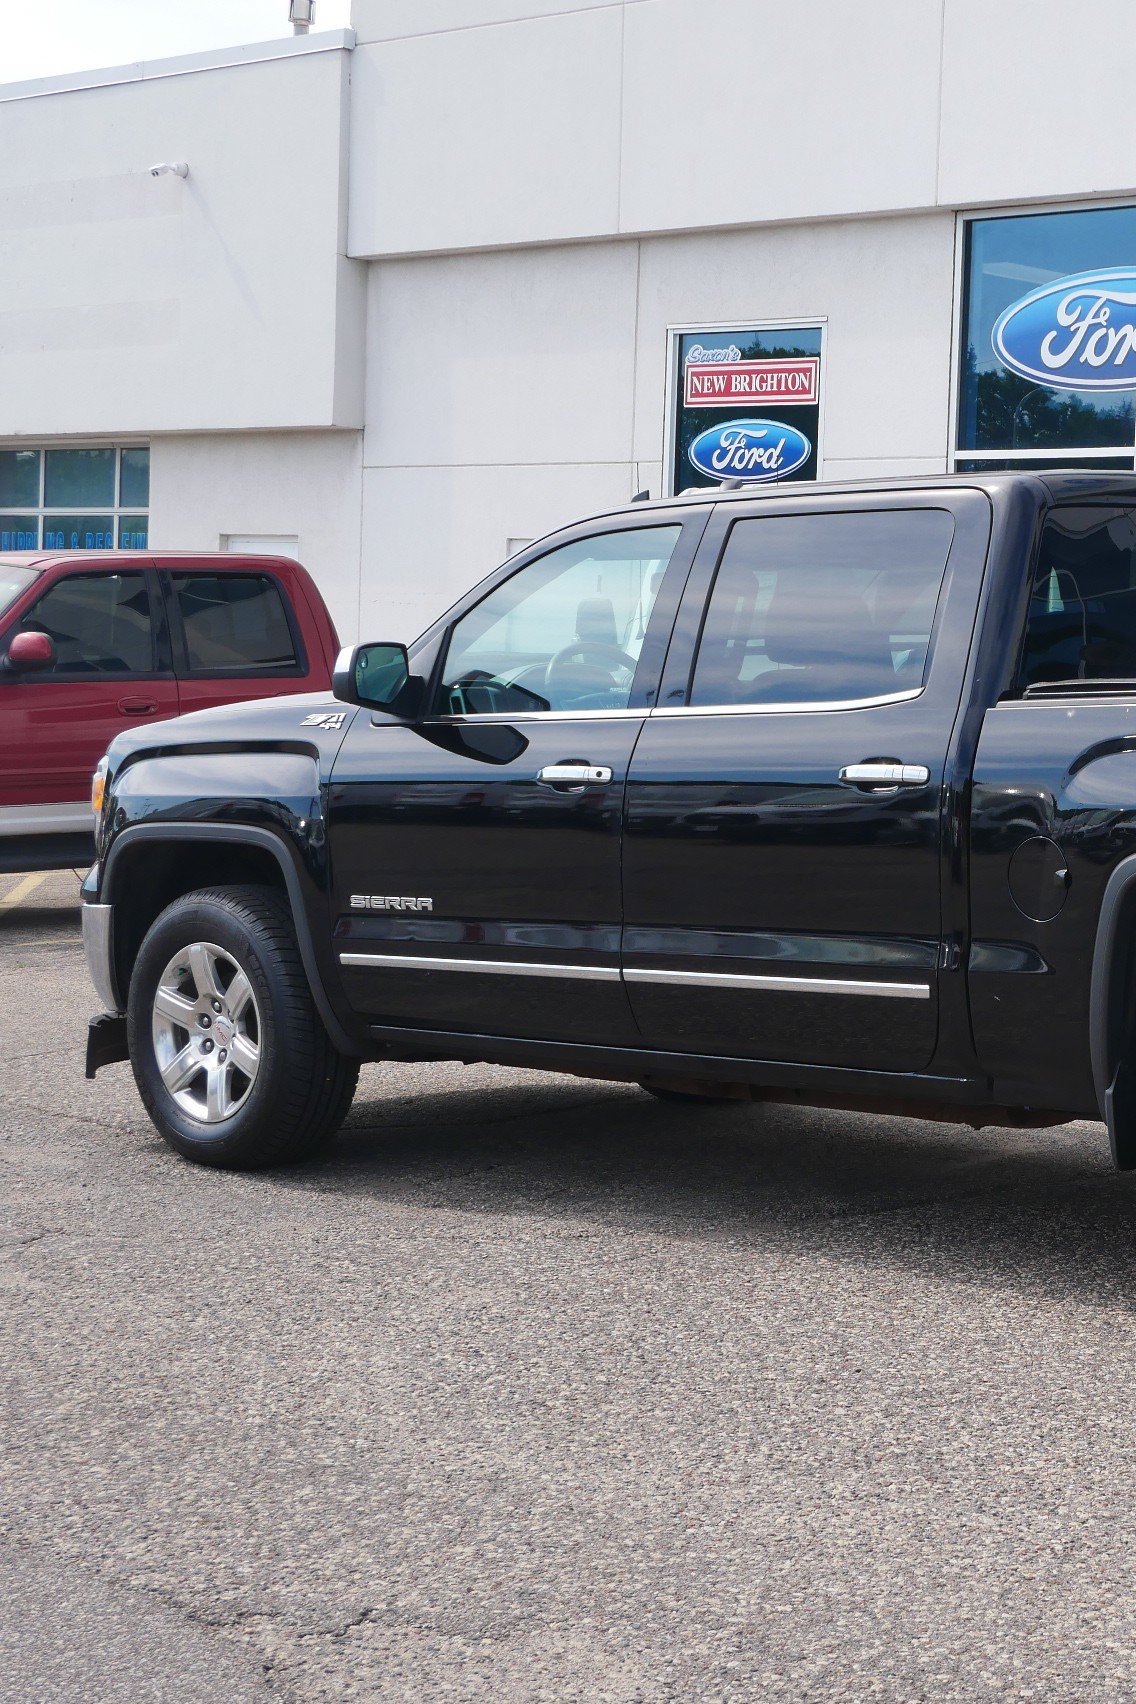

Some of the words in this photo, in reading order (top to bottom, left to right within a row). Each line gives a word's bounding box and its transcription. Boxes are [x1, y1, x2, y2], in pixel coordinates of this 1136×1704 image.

[685, 344, 742, 364] Saxon's
[691, 375, 727, 394] NEW
[731, 372, 811, 393] BRIGHTON
[711, 427, 787, 471] Ford
[299, 712, 347, 727] Z71
[350, 894, 433, 911] SIERRA
